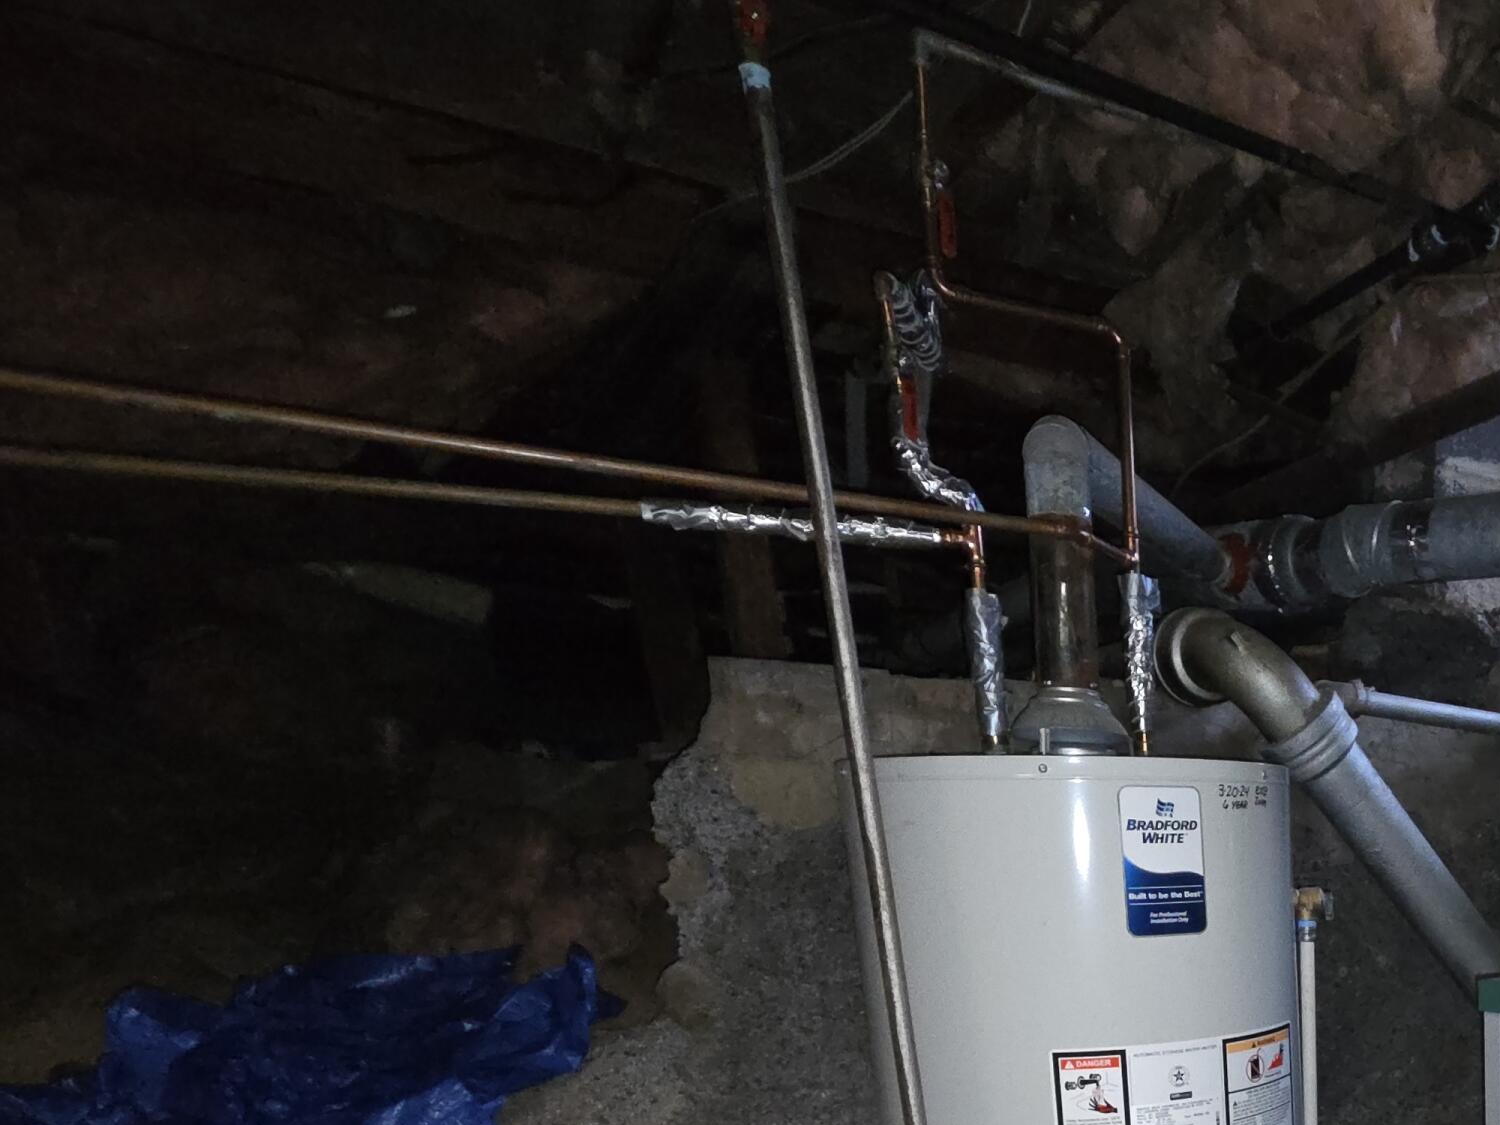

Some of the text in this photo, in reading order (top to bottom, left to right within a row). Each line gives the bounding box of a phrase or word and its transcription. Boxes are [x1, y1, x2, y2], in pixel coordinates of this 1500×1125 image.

[1126, 819, 1198, 831] BRADFORD
[1142, 832, 1185, 844] WHITE
[1075, 1058, 1112, 1067] DANGER
